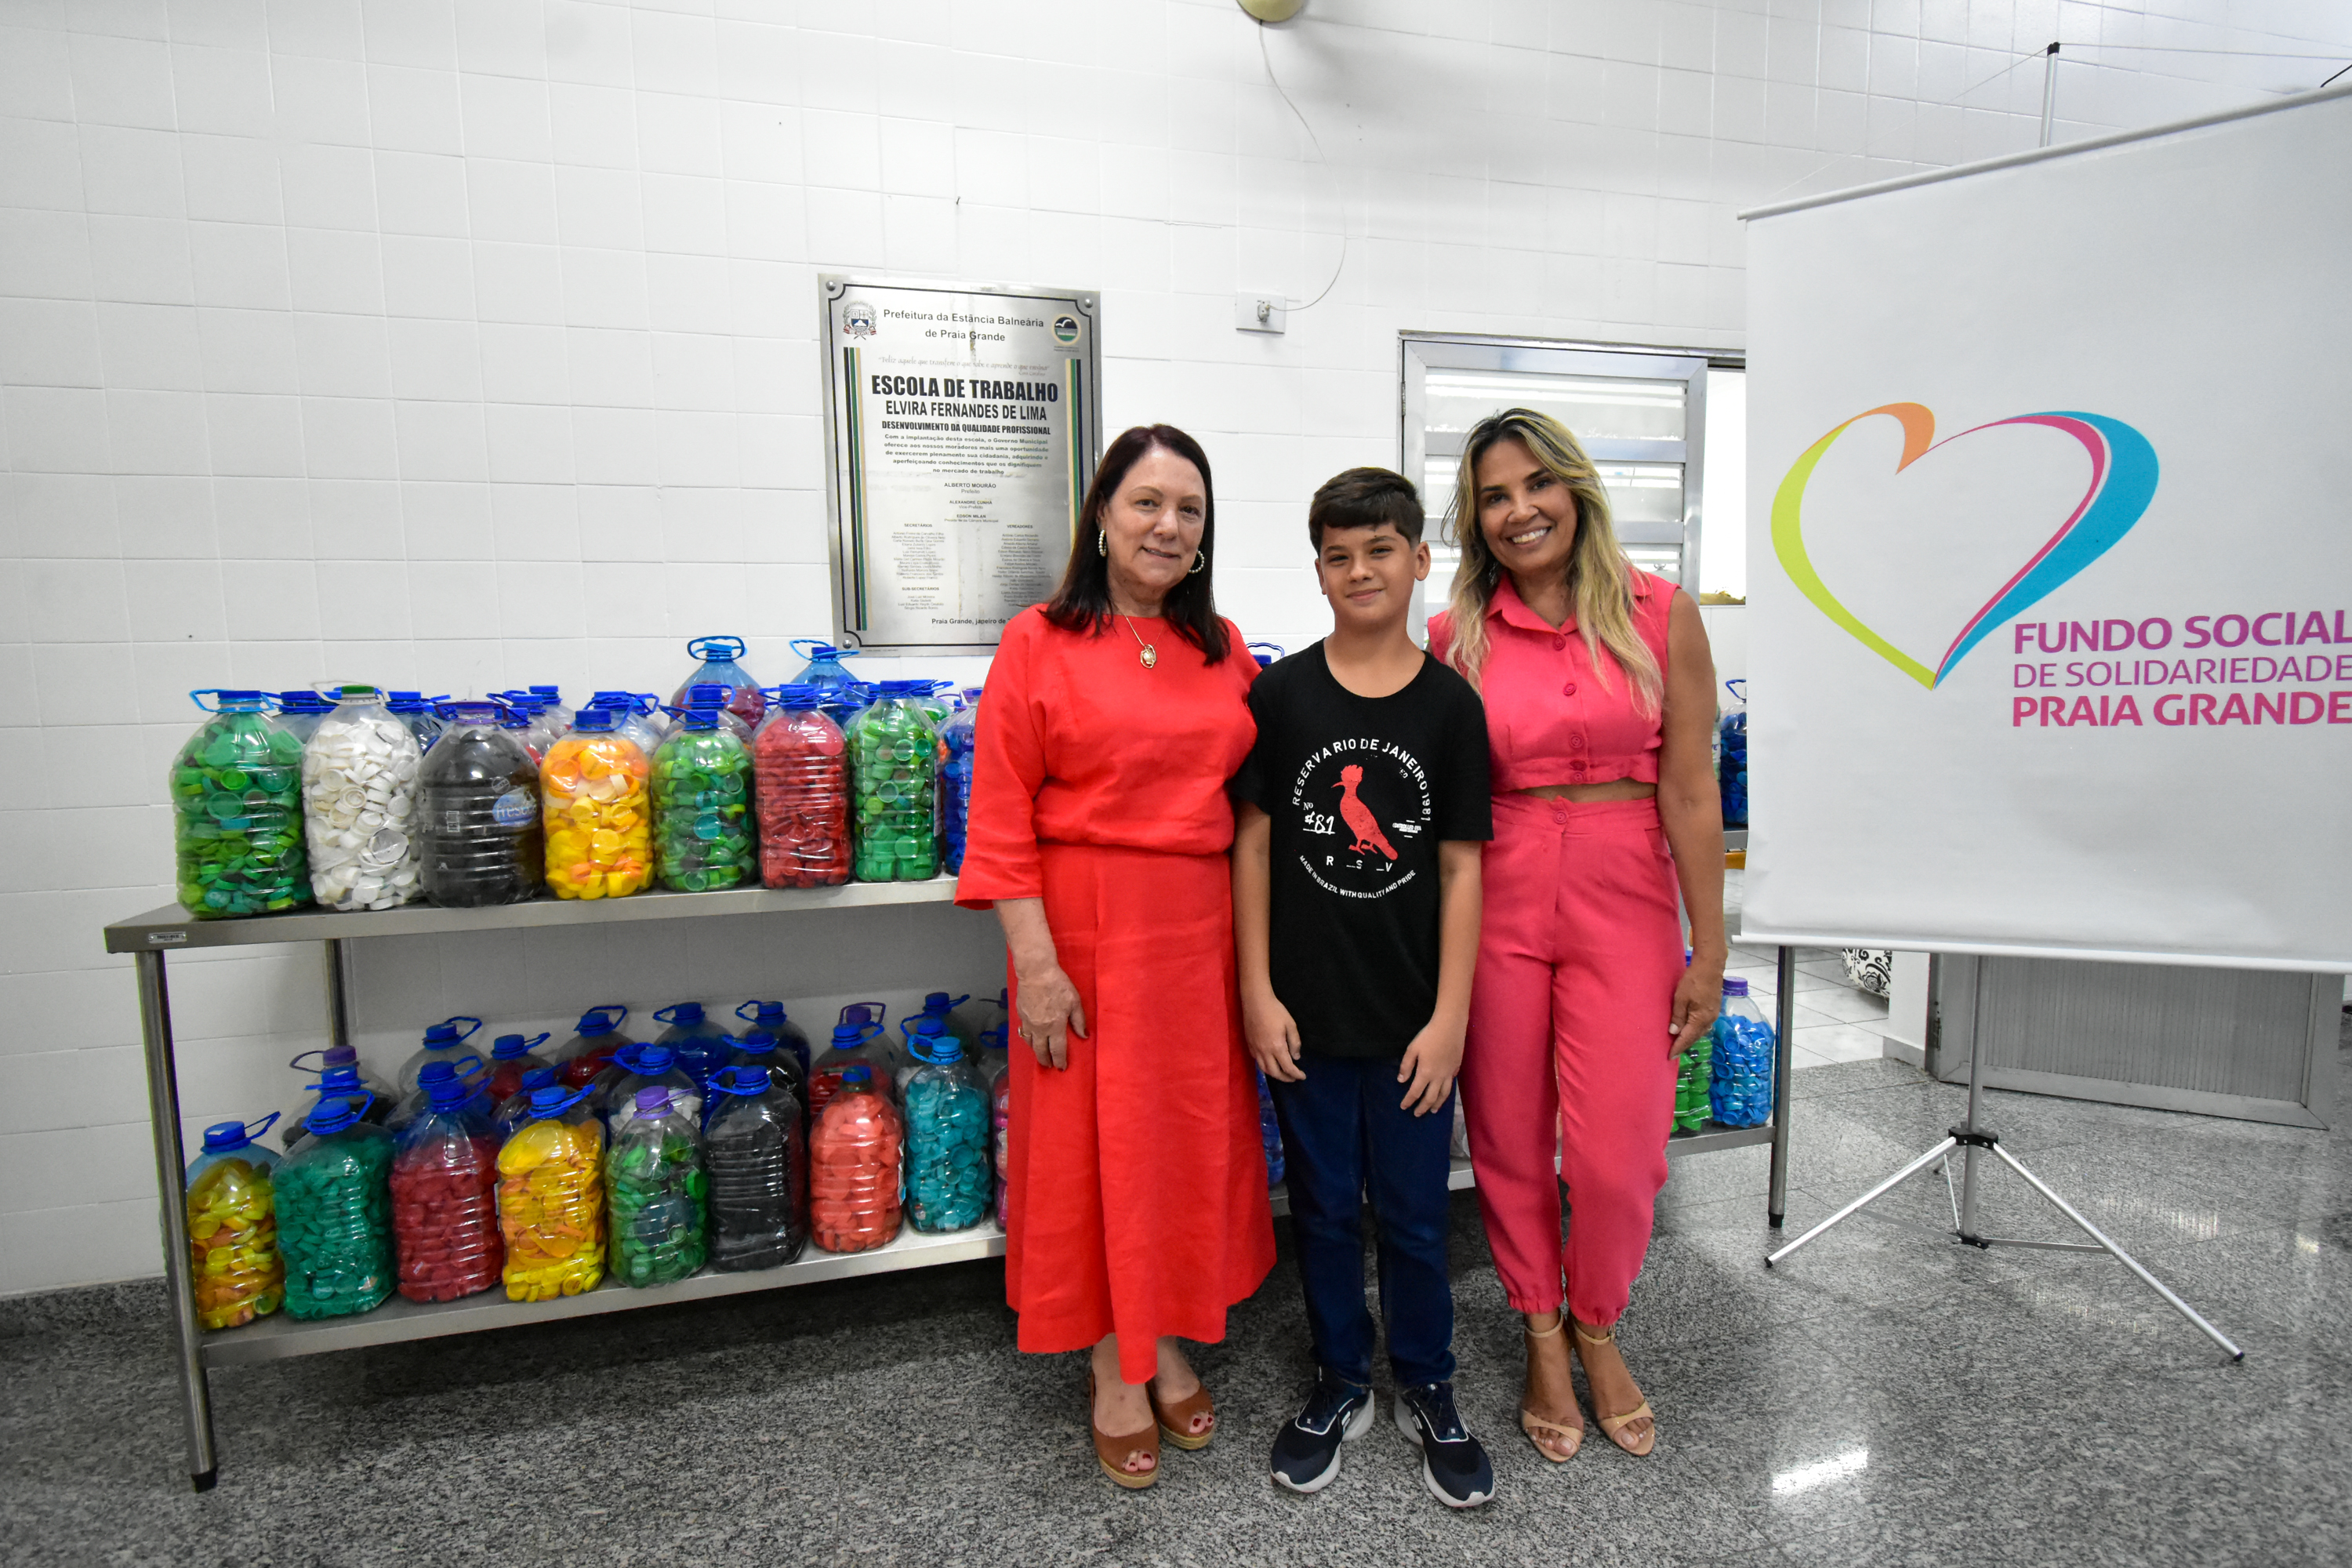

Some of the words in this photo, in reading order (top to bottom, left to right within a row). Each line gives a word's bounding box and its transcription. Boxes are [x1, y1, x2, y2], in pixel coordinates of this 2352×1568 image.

[884, 310, 933, 320] Prefeitura
[952, 314, 994, 324] Estância
[998, 317, 1044, 327] Balneária
[941, 330, 965, 339] Praia
[970, 331, 1005, 341] Grande
[872, 375, 939, 397] ESCOLA
[944, 378, 965, 397] DE
[969, 379, 1058, 402] TRABALHO
[886, 401, 927, 416] ELVIRA
[931, 402, 998, 419] FERNANDES
[1003, 405, 1016, 419] DE
[1020, 405, 1047, 420] LIMA
[882, 421, 949, 431] DESENVOLVIMENTO
[962, 424, 1000, 433] QUALIDADE
[1002, 426, 1051, 434] PROFISSIONAL
[2015, 617, 2172, 654] FUNDO
[2183, 610, 2352, 648] SOCIAL
[2014, 663, 2057, 688] DE
[2065, 655, 2352, 687] SOLIDARIEDADE
[2013, 695, 2143, 726] PRAIA
[2153, 691, 2352, 725] GRANDE
[1292, 747, 1332, 805] RESERVA
[1333, 739, 1356, 753] RIO
[1360, 739, 1379, 750] DE
[1382, 742, 1427, 790] JANEIRO
[1421, 793, 1431, 821] 1981
[1327, 855, 1334, 866] R
[1300, 855, 1313, 873] MADE
[1316, 877, 1338, 893] BRAZIL
[1340, 888, 1356, 898] WITH
[1358, 889, 1385, 898] QUALITY
[1385, 882, 1397, 894] AND
[1397, 870, 1416, 886] PRIDE
